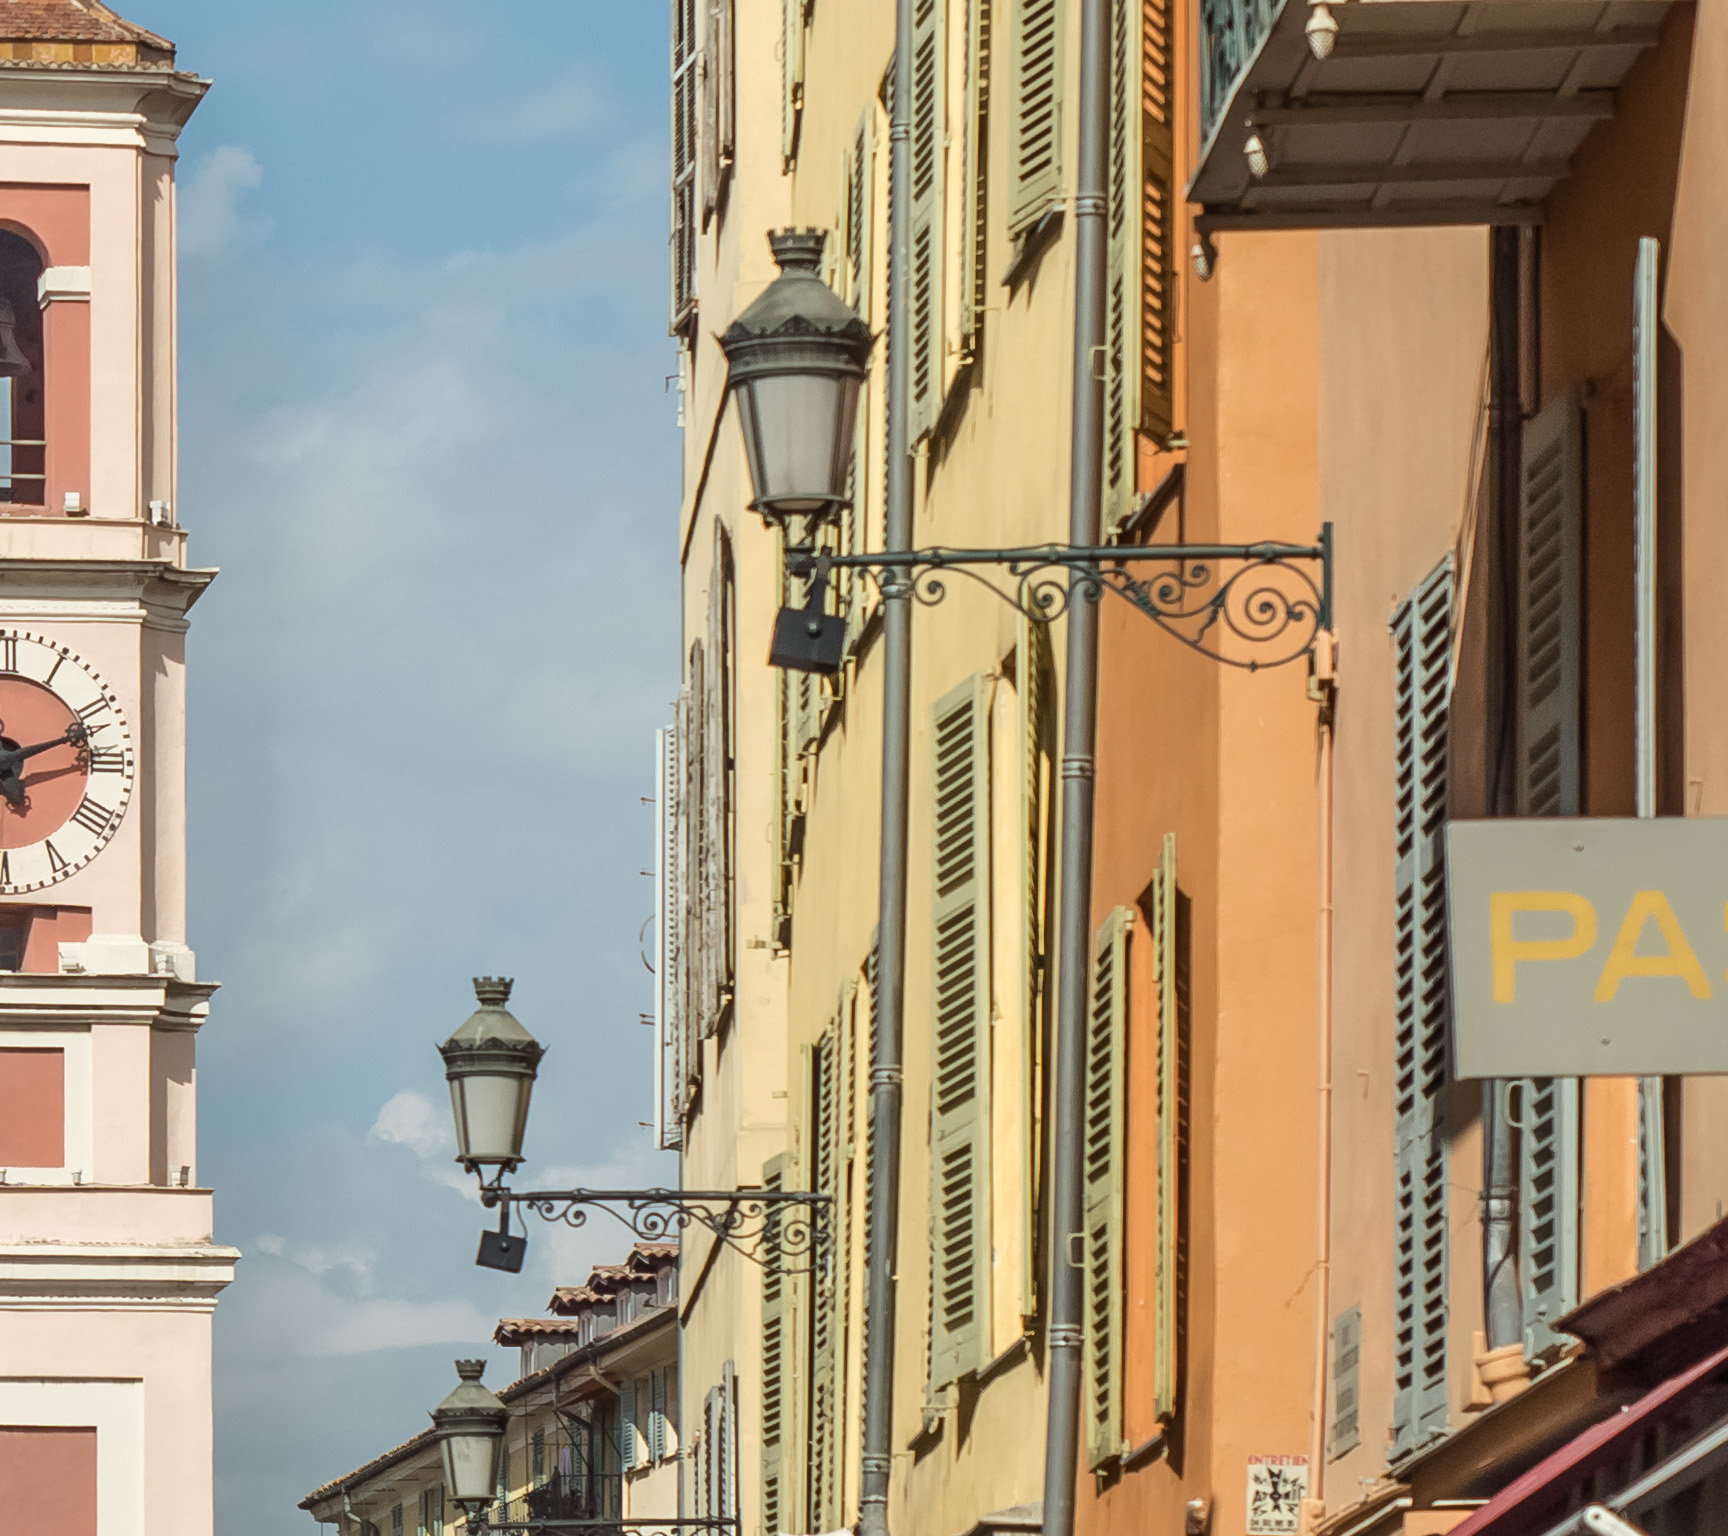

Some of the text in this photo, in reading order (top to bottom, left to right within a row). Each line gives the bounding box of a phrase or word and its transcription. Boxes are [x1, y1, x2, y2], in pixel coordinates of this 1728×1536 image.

[42, 654, 68, 688] I
[73, 693, 112, 722] II
[89, 750, 125, 776] III
[69, 793, 115, 839] IIII
[44, 839, 71, 874] V
[1489, 890, 1728, 1004] PA
[1247, 1454, 1309, 1465] ENTRETIEN
